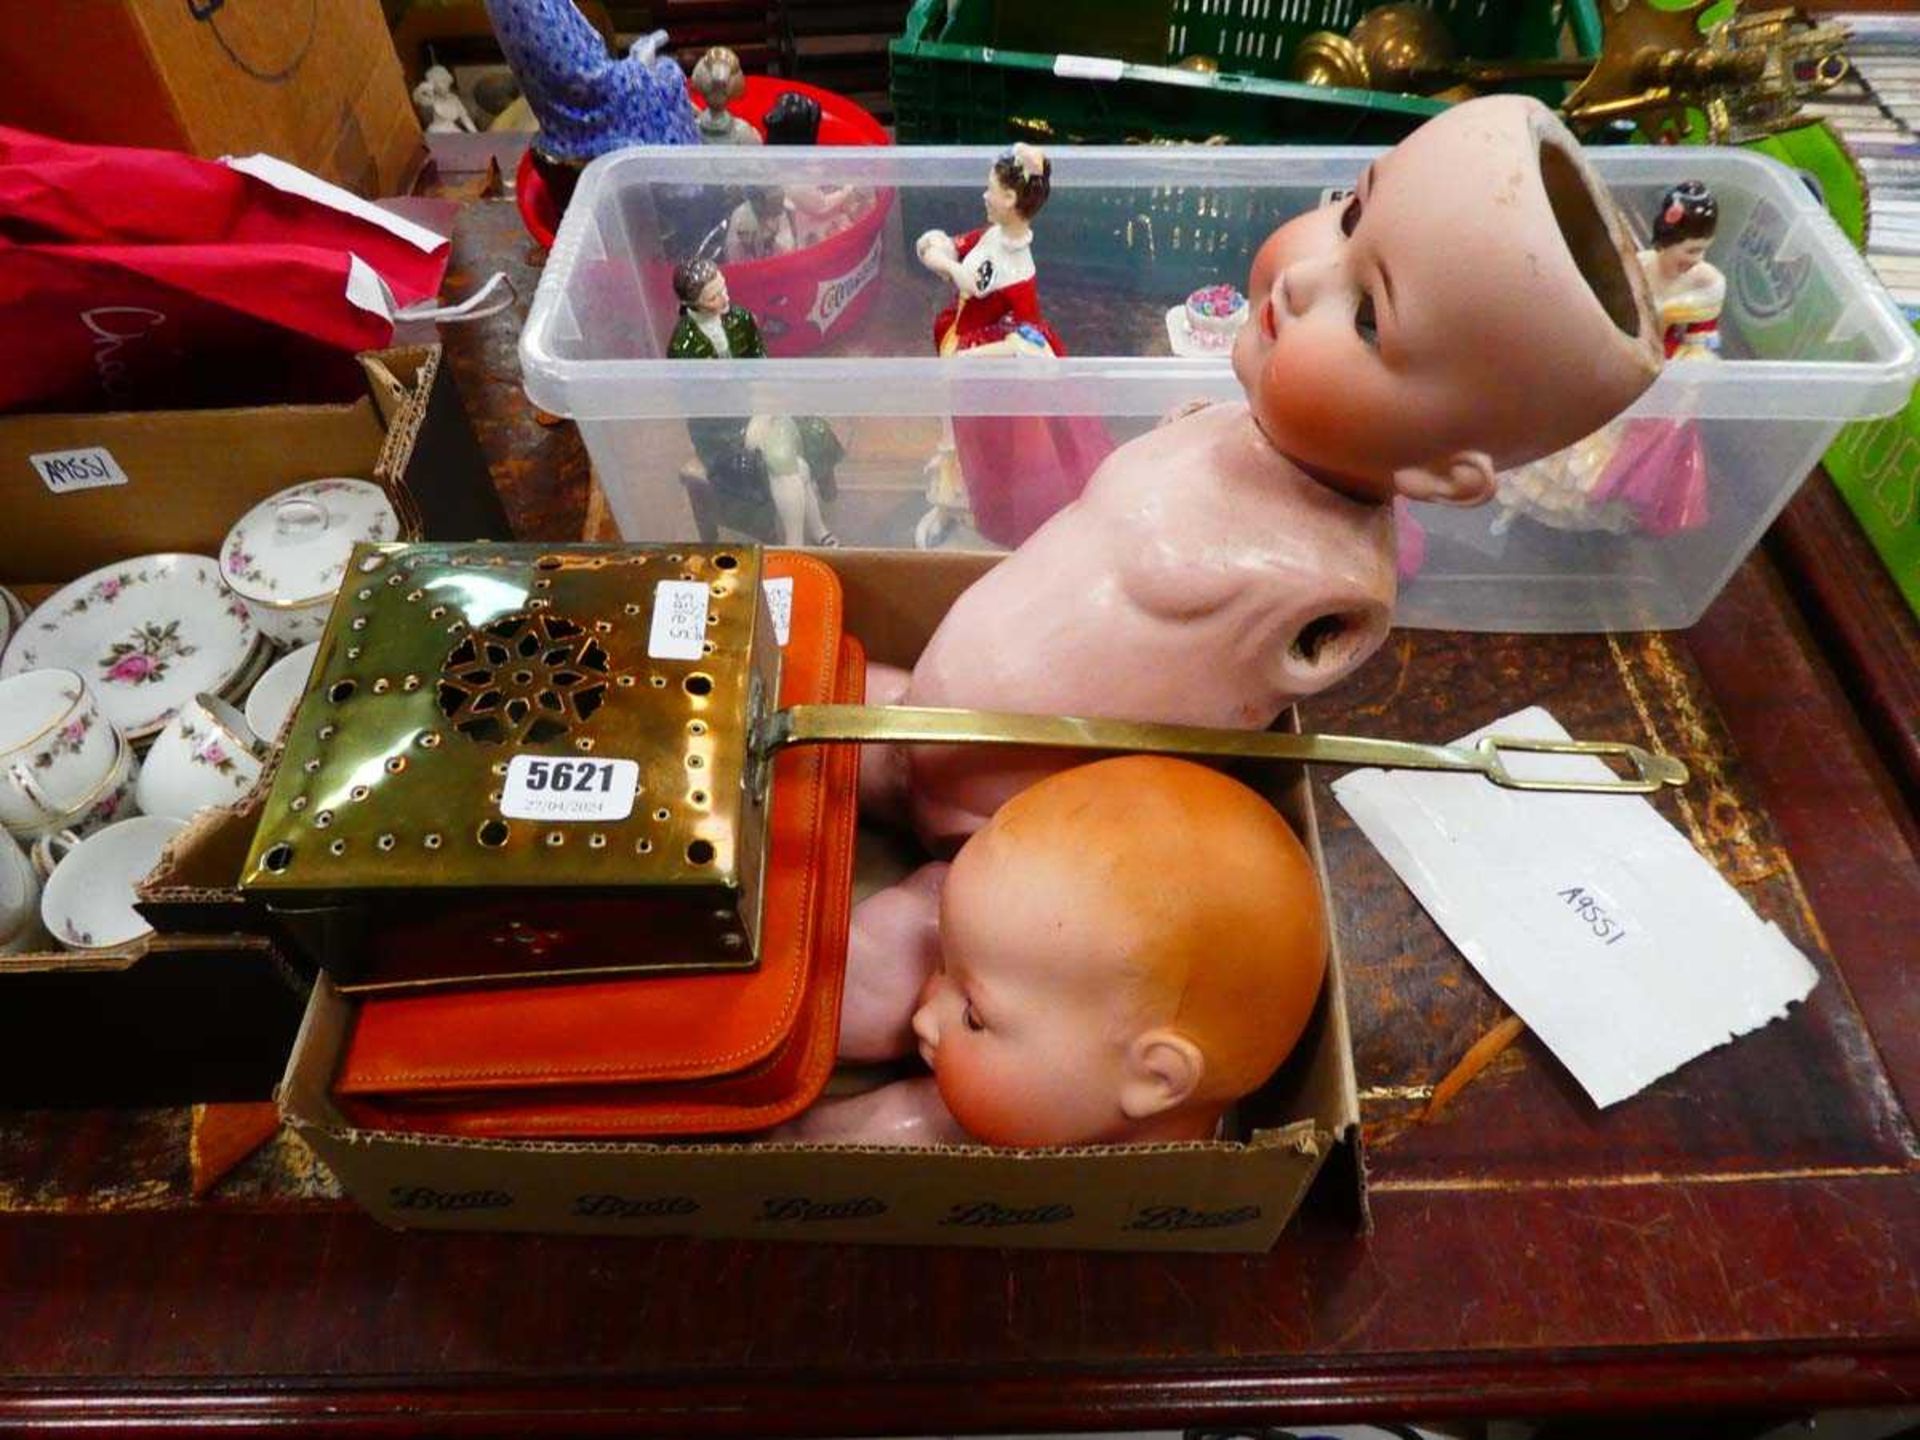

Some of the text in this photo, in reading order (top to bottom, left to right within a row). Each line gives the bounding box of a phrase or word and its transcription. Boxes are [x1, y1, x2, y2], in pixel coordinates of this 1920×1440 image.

[525, 760, 615, 793] 5621
[1557, 887, 1626, 945] A9551
[390, 1185, 514, 1212] Boots
